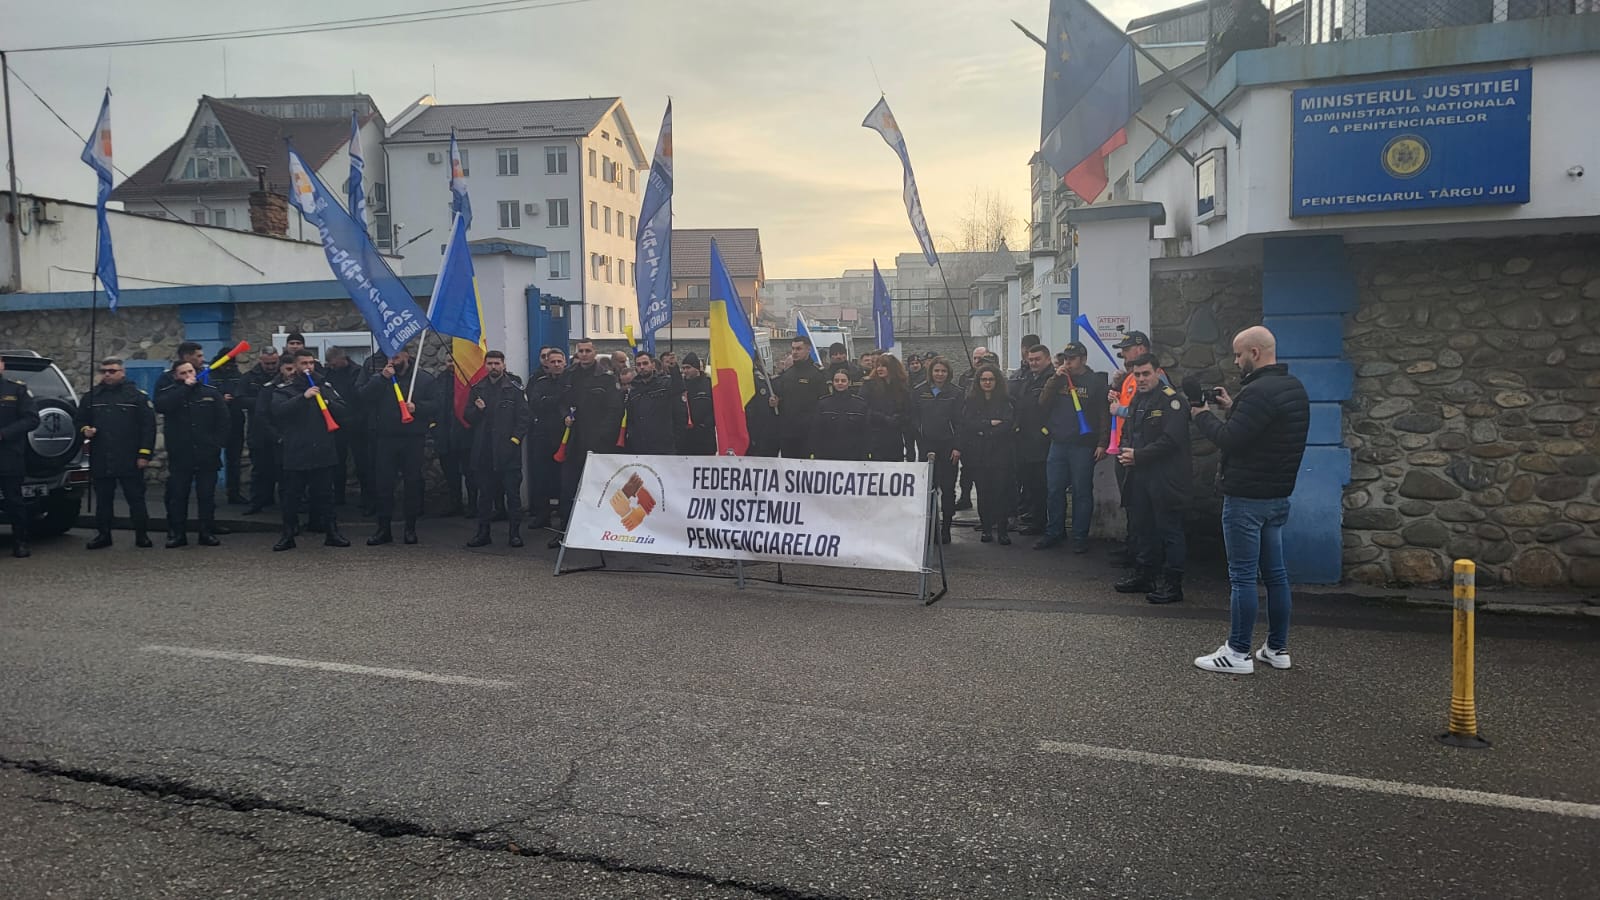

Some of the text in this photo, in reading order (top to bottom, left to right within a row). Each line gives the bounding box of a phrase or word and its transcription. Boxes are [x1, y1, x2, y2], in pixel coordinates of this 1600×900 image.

[1301, 78, 1520, 110] MINISTERUL JUSTITIEI
[1303, 97, 1516, 123] ADMINISTRATIA NATIONALA
[1328, 113, 1487, 135] A PENITENCIARELOR
[1302, 190, 1425, 207] PENITENCIARUL
[1488, 184, 1517, 196] JIU
[692, 467, 780, 497] FEDERAȚIA
[784, 471, 916, 497] SINDICATELOR
[687, 497, 804, 526] DIN SISTEMUL
[601, 530, 656, 545] Romania
[687, 527, 841, 558] PENITENCIARELOR
